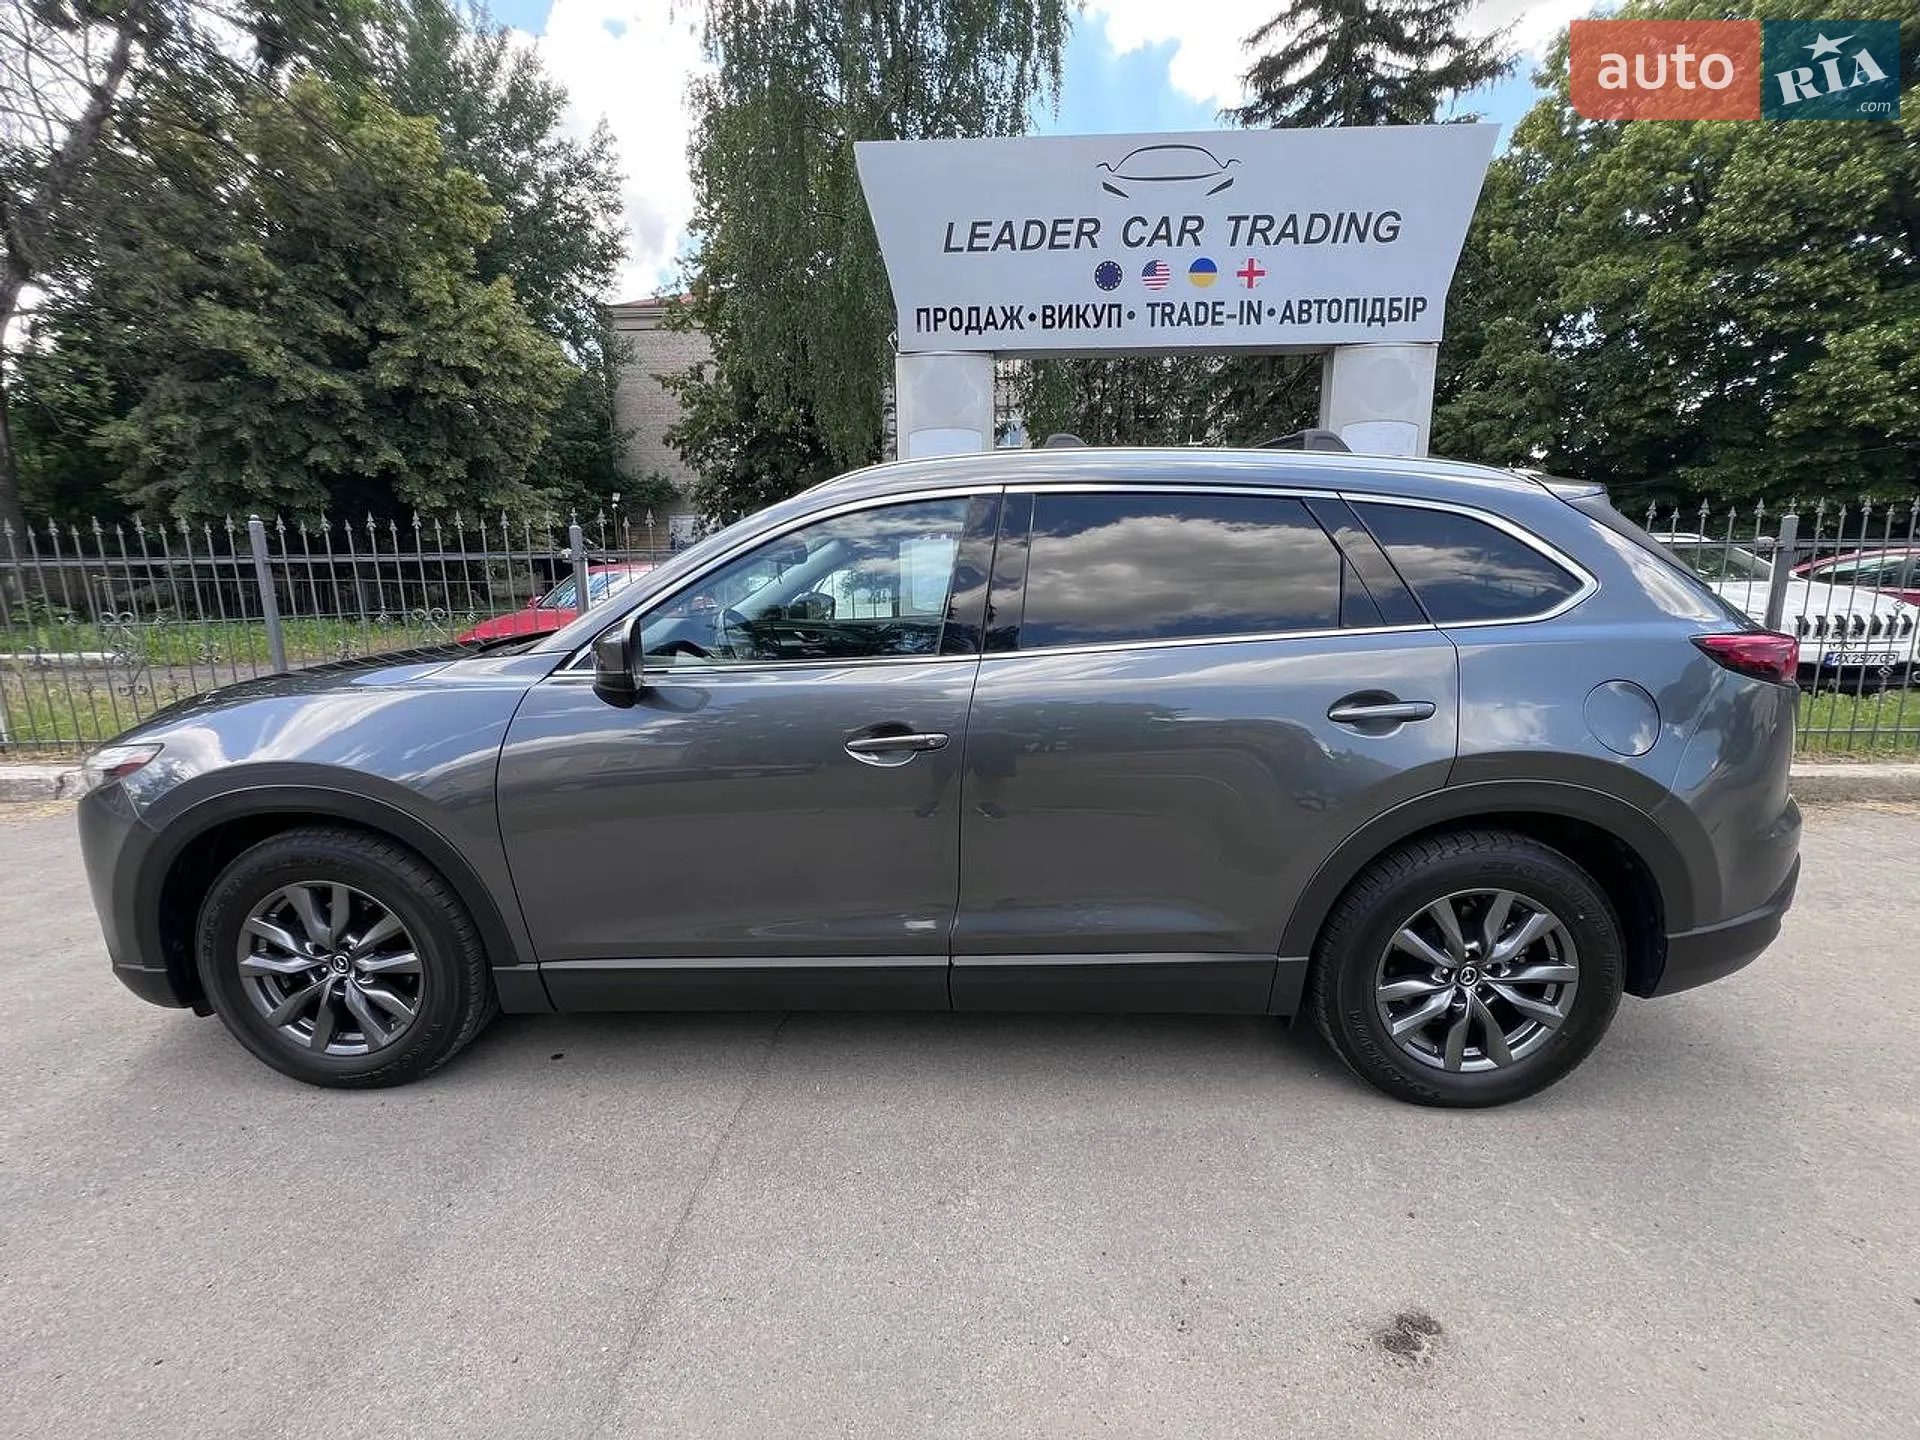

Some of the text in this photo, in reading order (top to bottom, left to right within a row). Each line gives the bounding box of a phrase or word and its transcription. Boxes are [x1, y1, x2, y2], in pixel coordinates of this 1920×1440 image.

[943, 210, 1402, 254] LEADER CAR TRADING
[1146, 299, 1263, 328] TRADE-IN
